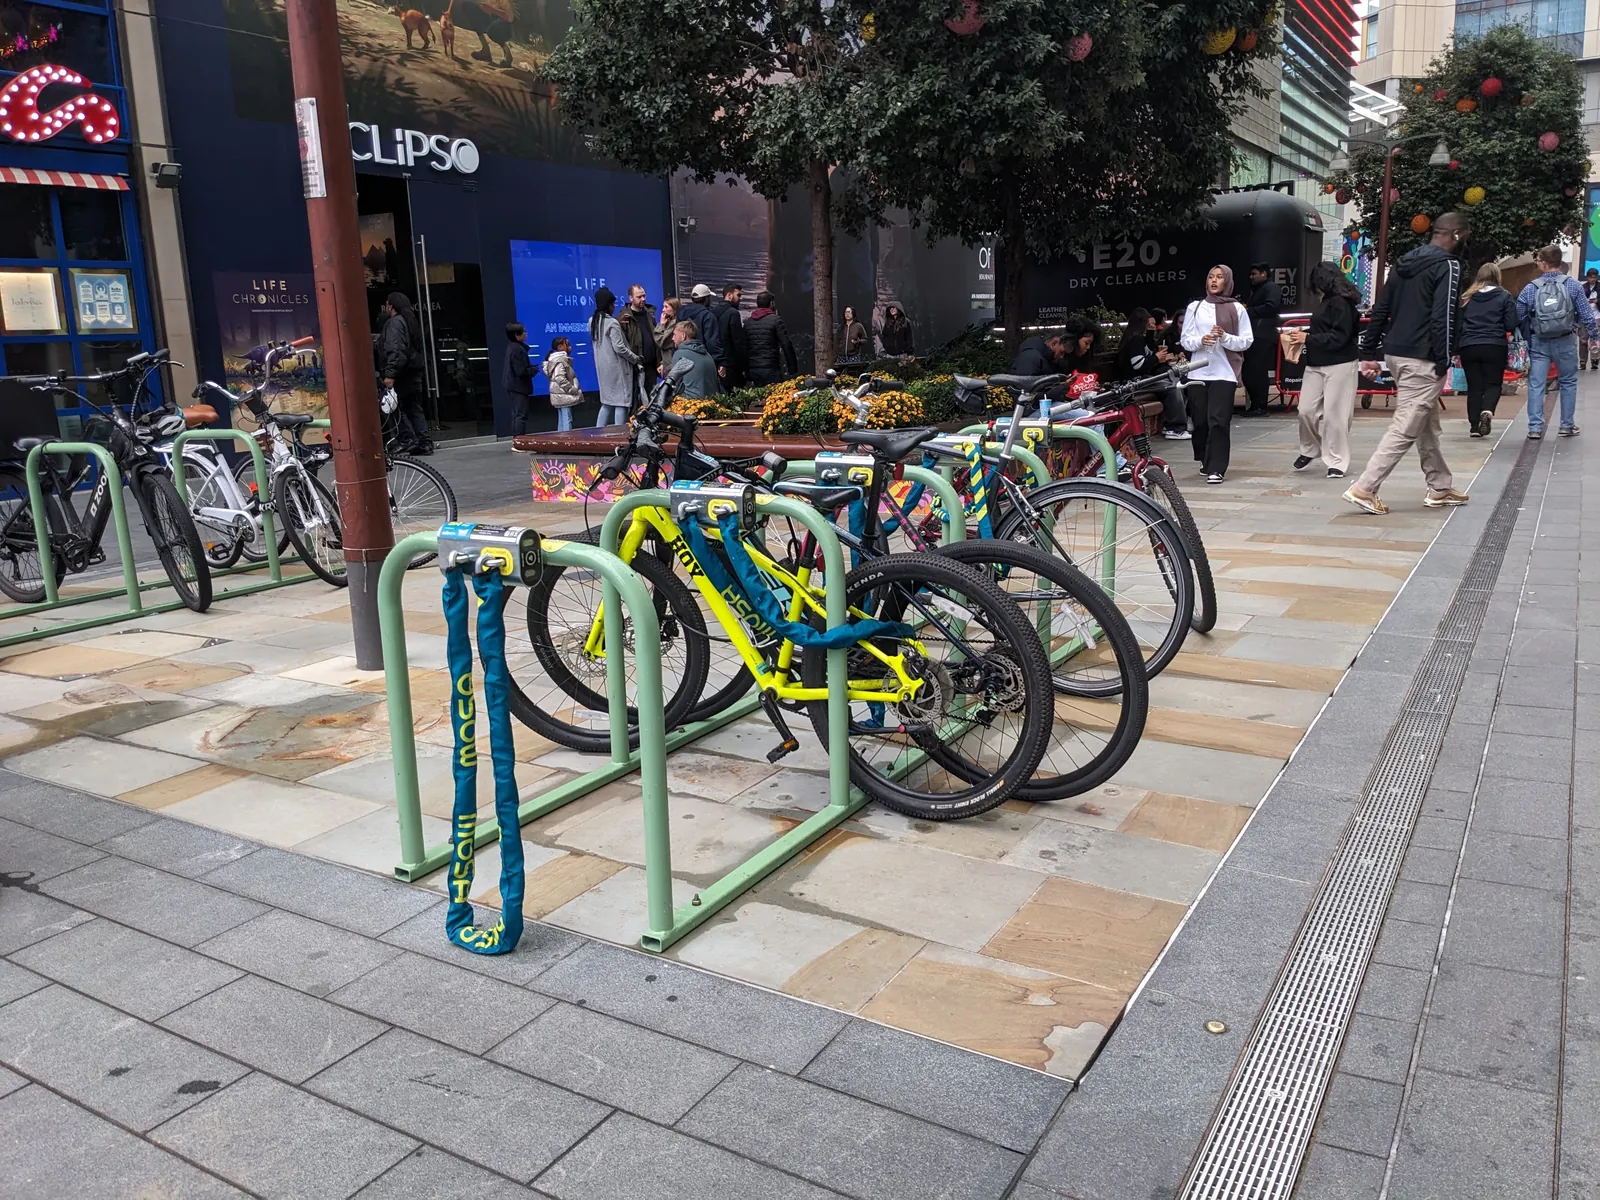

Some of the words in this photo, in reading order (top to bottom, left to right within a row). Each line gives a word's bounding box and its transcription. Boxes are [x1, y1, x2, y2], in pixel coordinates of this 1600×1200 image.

[1093, 239, 1161, 270] E20
[1069, 276, 1099, 289] DRY
[1105, 269, 1187, 286] CLEANERS
[1270, 267, 1297, 284] EY
[252, 279, 287, 291] LIFE
[575, 277, 606, 290] LIFE
[1281, 285, 1297, 295] OB
[232, 293, 309, 305] CHRONICLES
[556, 294, 625, 306] CHRONES
[1076, 451, 1103, 478] ndale
[258, 499, 277, 512] KRY
[670, 534, 705, 578] HOY
[846, 571, 885, 595] KENDA
